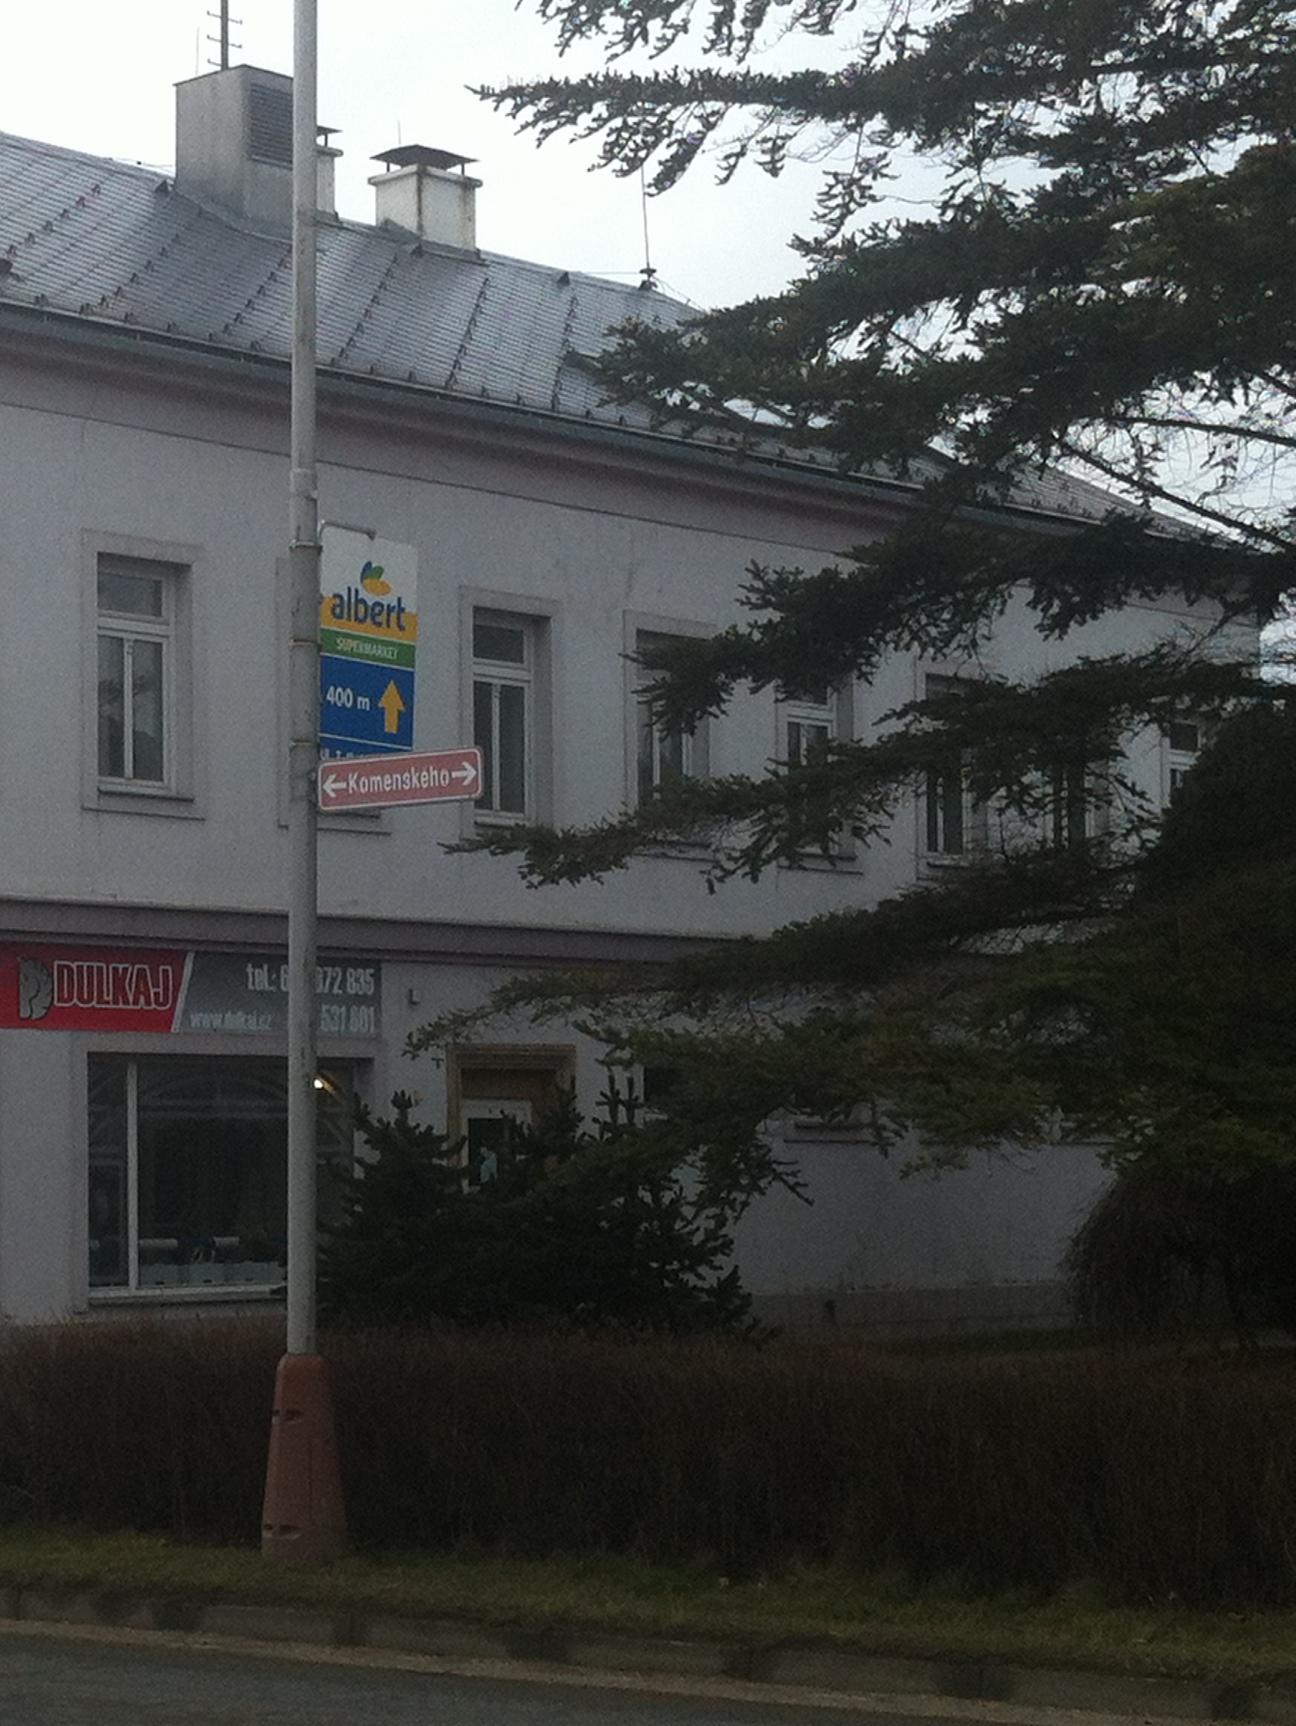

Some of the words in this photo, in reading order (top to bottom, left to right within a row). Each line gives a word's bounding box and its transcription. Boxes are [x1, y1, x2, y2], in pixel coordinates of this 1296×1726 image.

[331, 587, 405, 631] albert
[335, 636, 399, 660] SUPERMARKET
[326, 685, 353, 708] 400
[356, 692, 370, 711] m
[54, 960, 172, 1010] DULKAJ
[346, 967, 375, 995] 835
